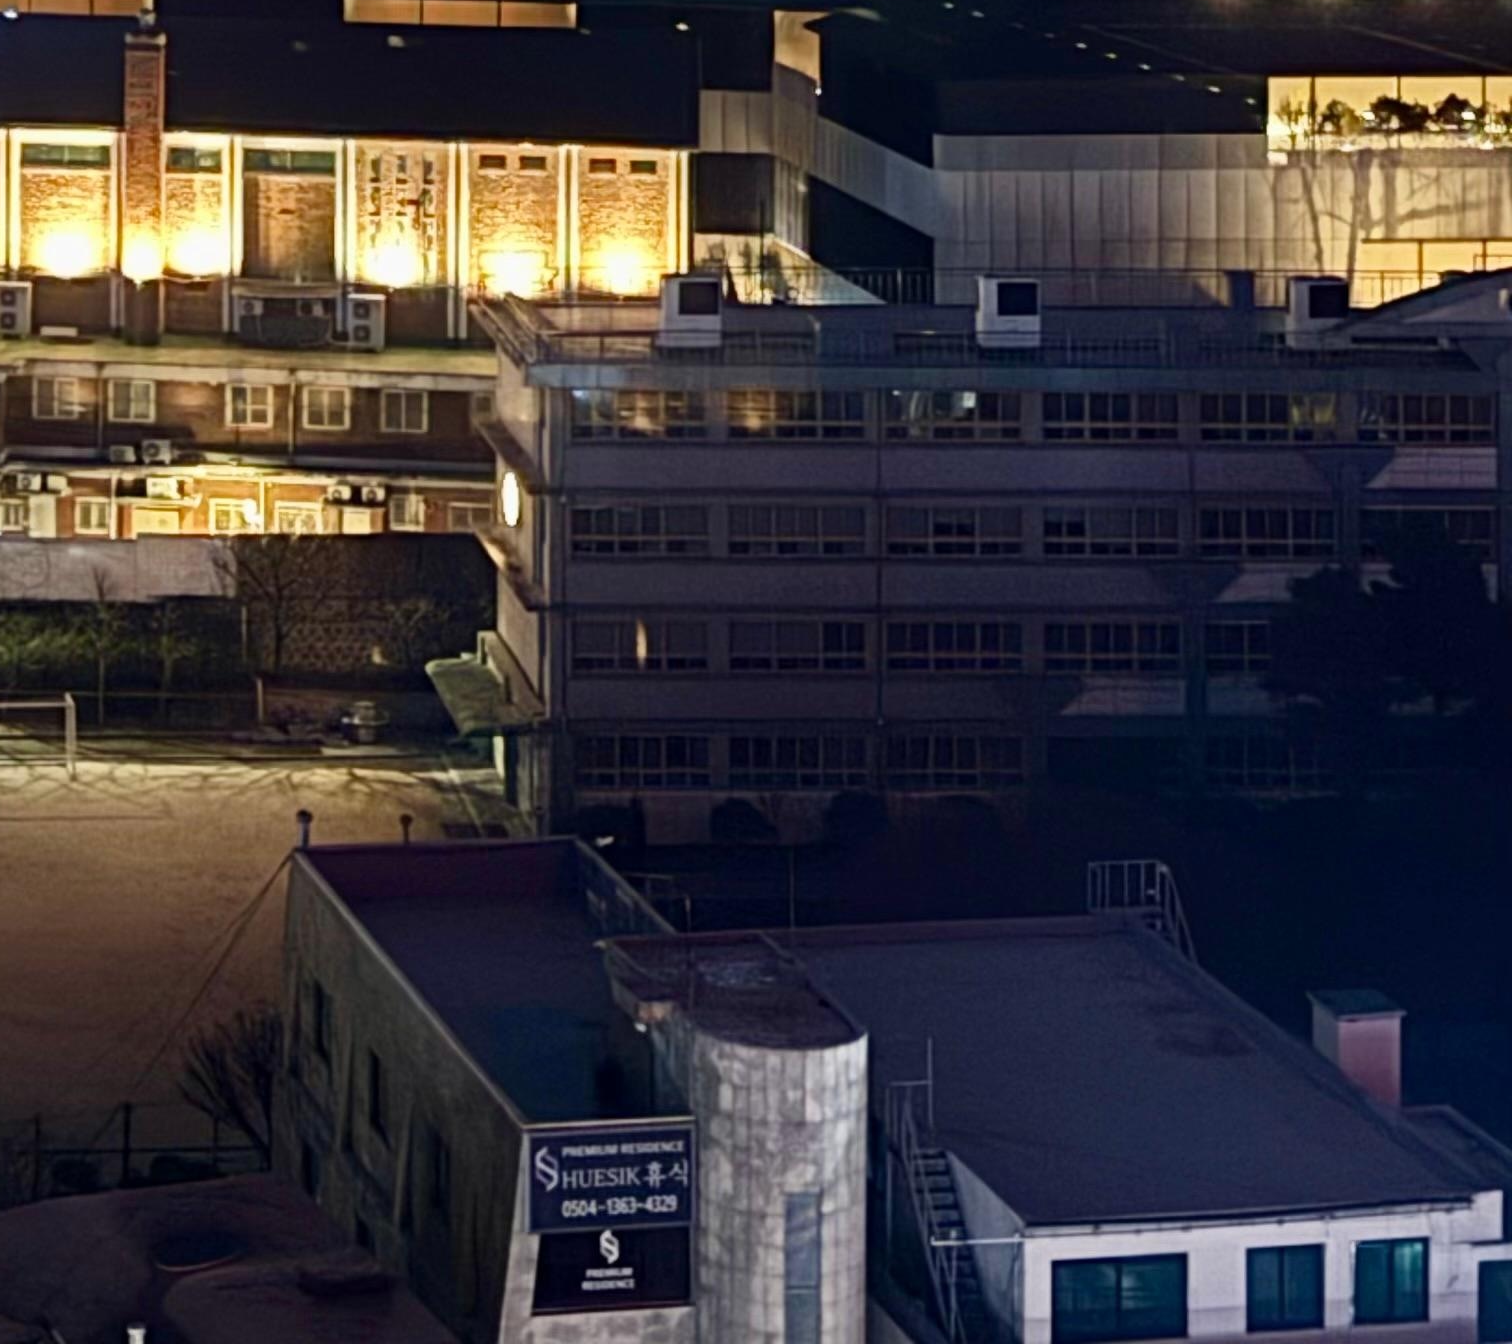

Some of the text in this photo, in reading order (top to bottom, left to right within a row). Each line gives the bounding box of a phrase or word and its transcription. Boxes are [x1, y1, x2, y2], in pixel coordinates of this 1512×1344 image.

[561, 1141, 684, 1156] PREMIUM RESIDENCE
[562, 1159, 689, 1189] HUESIK 휴식
